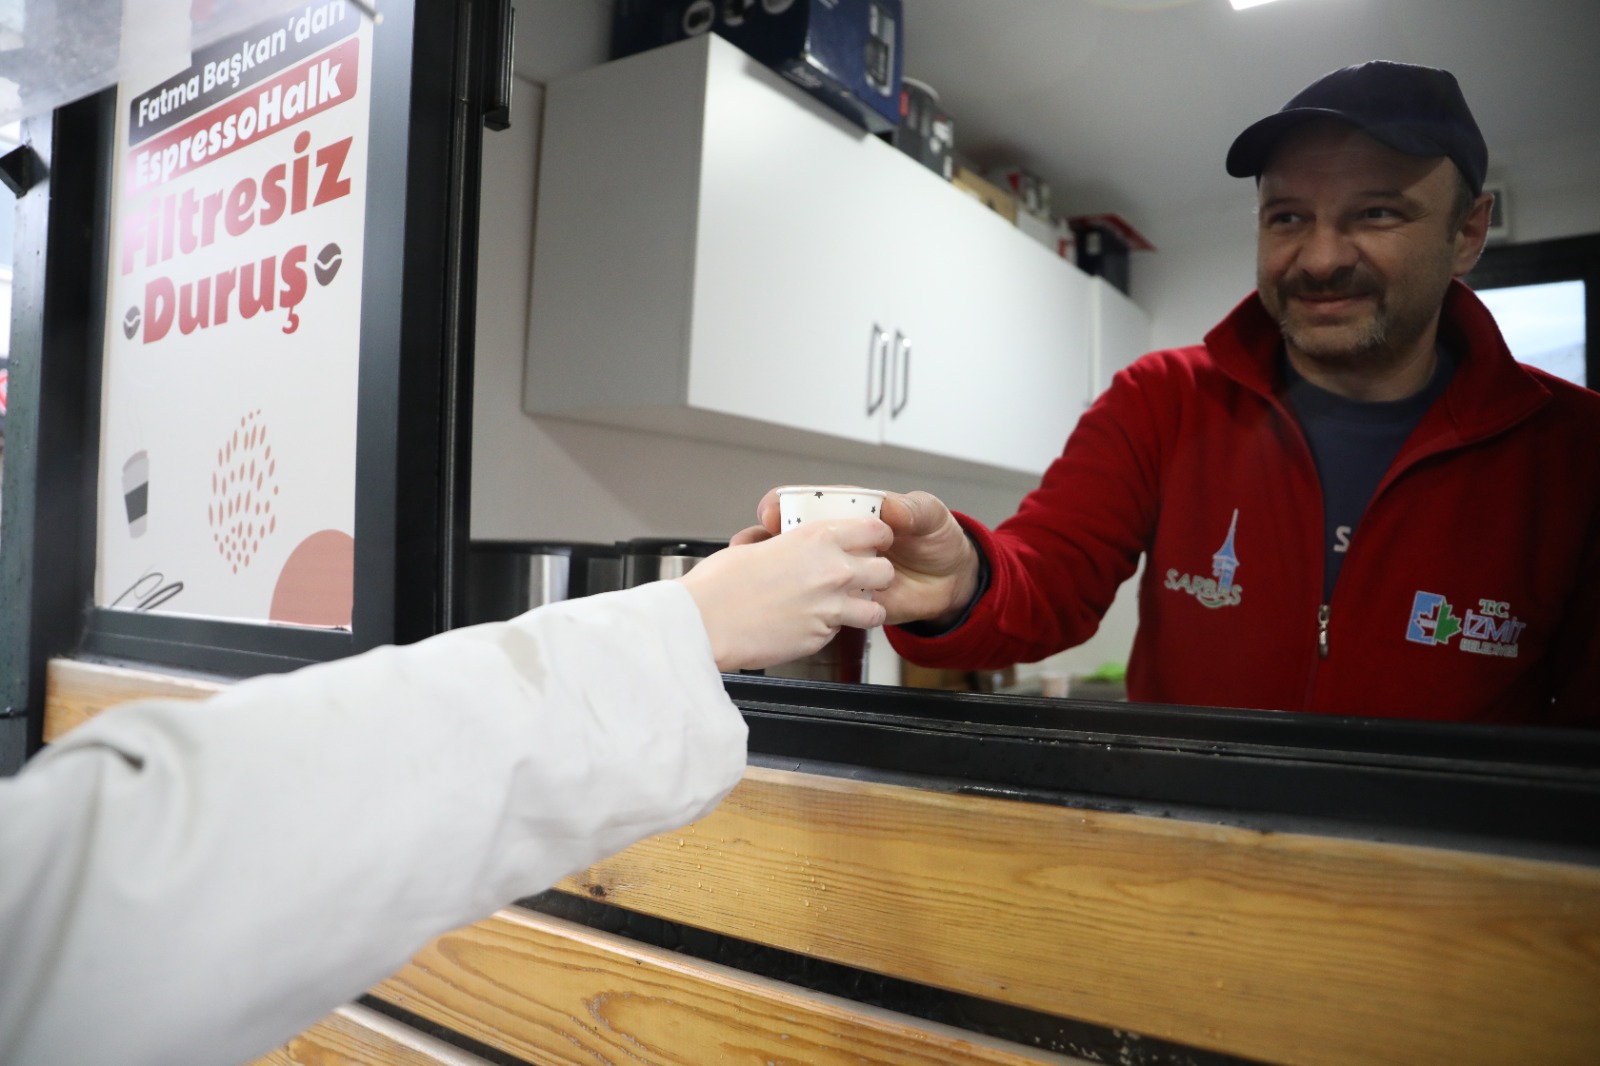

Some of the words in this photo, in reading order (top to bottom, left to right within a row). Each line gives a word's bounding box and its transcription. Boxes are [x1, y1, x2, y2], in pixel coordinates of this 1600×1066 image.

[135, 61, 342, 187] EspressoHalk
[138, 76, 199, 128] Fatma
[121, 130, 353, 276] Filtresiz
[143, 244, 308, 345] Duruş
[1479, 598, 1510, 619] TC
